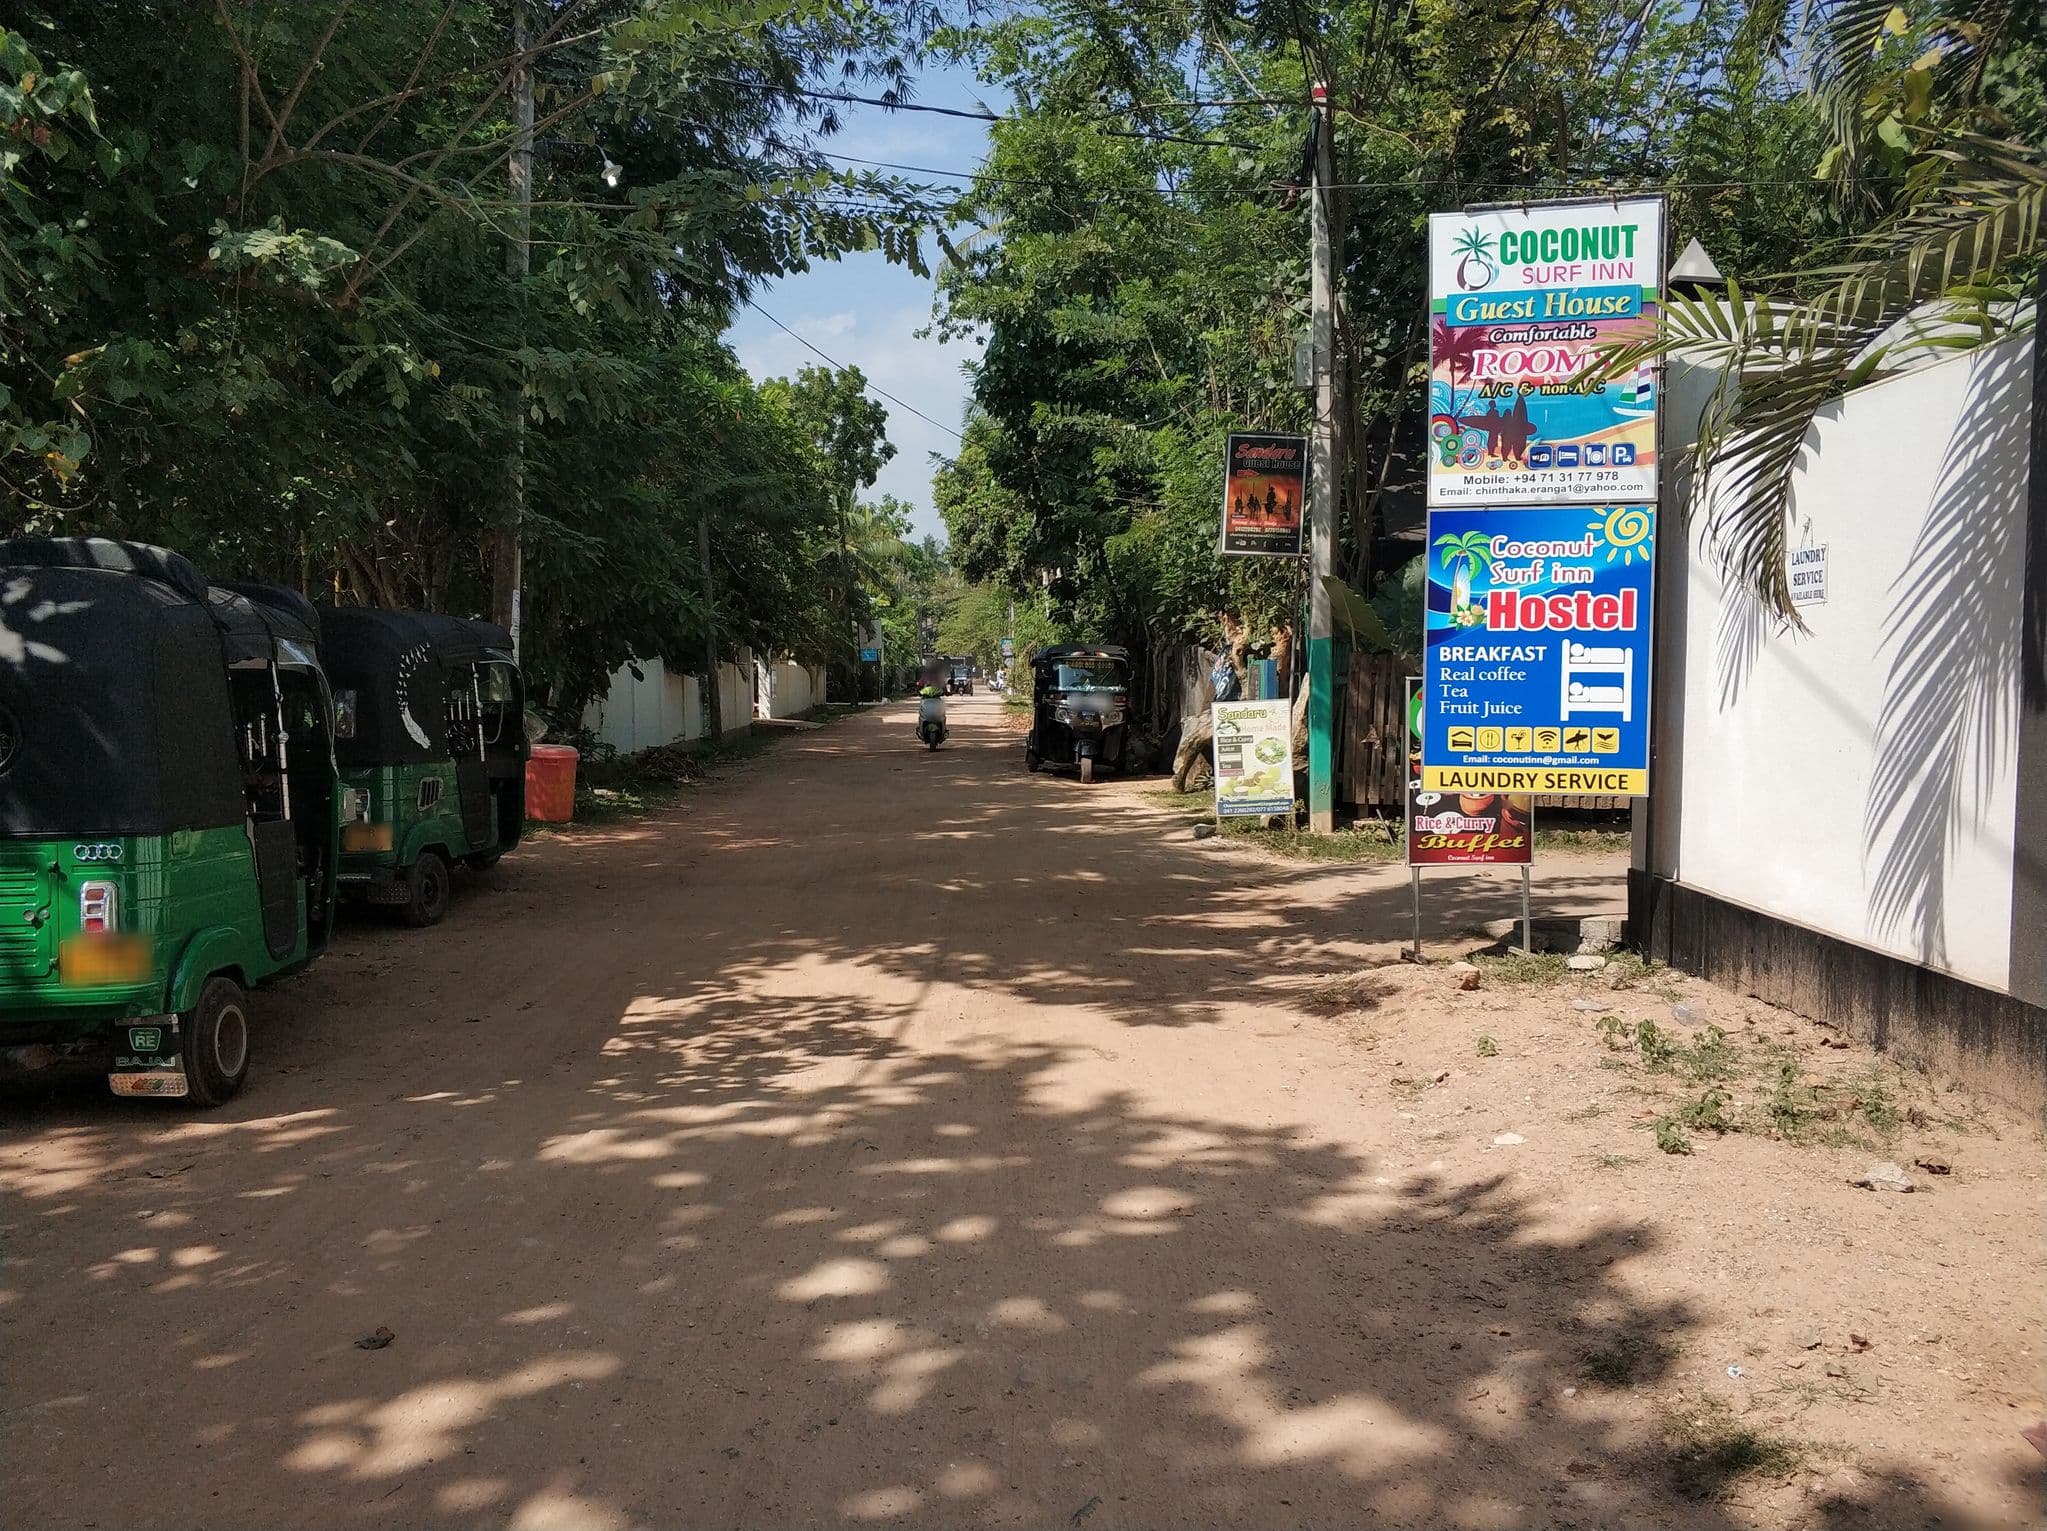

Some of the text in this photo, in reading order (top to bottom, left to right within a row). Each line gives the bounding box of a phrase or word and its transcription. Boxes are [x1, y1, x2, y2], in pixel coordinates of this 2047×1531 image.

[1499, 224, 1639, 266] COCONUT
[1521, 261, 1634, 285] SURF INN
[1455, 291, 1632, 322] Guest House
[1489, 323, 1597, 345] Comfortable
[1480, 382, 1513, 398] A/C
[1519, 383, 1533, 395] &
[1463, 471, 1619, 485] Mobile: +94 71 31 77 978
[1439, 483, 1644, 496] Email: chinthaka.eranga1@yahoo.com
[1491, 533, 1595, 557] Coconut
[1791, 548, 1826, 566] LAUNDRY
[1490, 561, 1593, 583] Surf inn
[1793, 570, 1823, 586] SERVICE
[1488, 590, 1636, 630] Hostel
[1439, 645, 1548, 662] BREAKFAST
[1439, 666, 1527, 681] Real coffee
[1439, 684, 1469, 698] Tea
[1218, 707, 1266, 720] Sandaru
[1439, 700, 1523, 719] Fruit Juice
[1463, 755, 1600, 766] Email: coconutinn@gmail.com
[1439, 771, 1629, 790] LAUNDRY SERVICE
[1415, 816, 1496, 833] Rice & Curry
[1416, 833, 1526, 853] Buffet
[134, 1035, 156, 1047] RE
